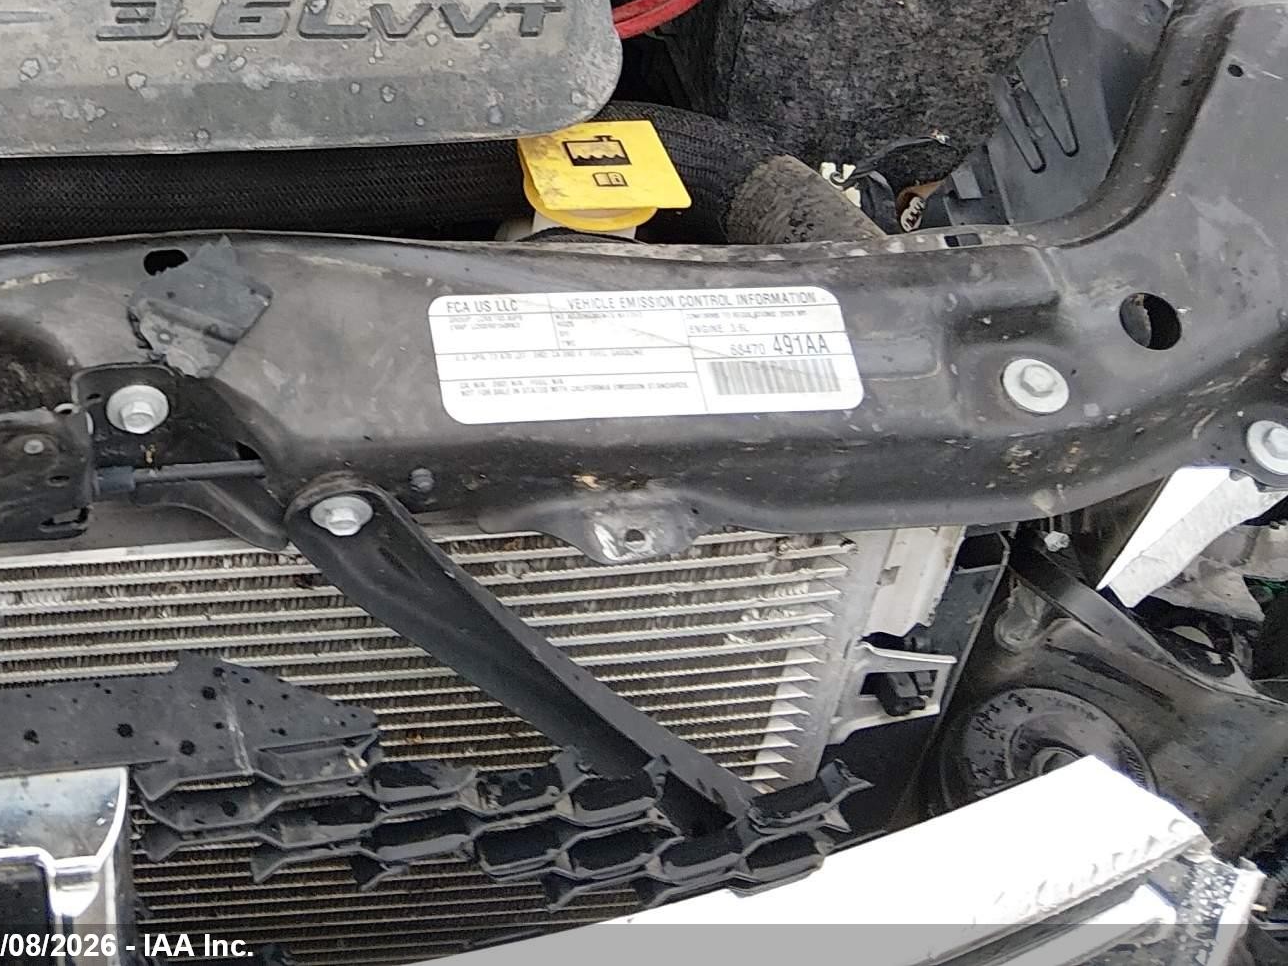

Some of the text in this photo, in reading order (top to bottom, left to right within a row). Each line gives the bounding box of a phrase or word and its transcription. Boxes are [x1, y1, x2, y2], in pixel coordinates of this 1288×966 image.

[446, 298, 518, 314] FCA US LLC
[566, 291, 817, 311] VEHICLE EMISSION CONTROL INFORMATION
[772, 333, 831, 355] 491AA
